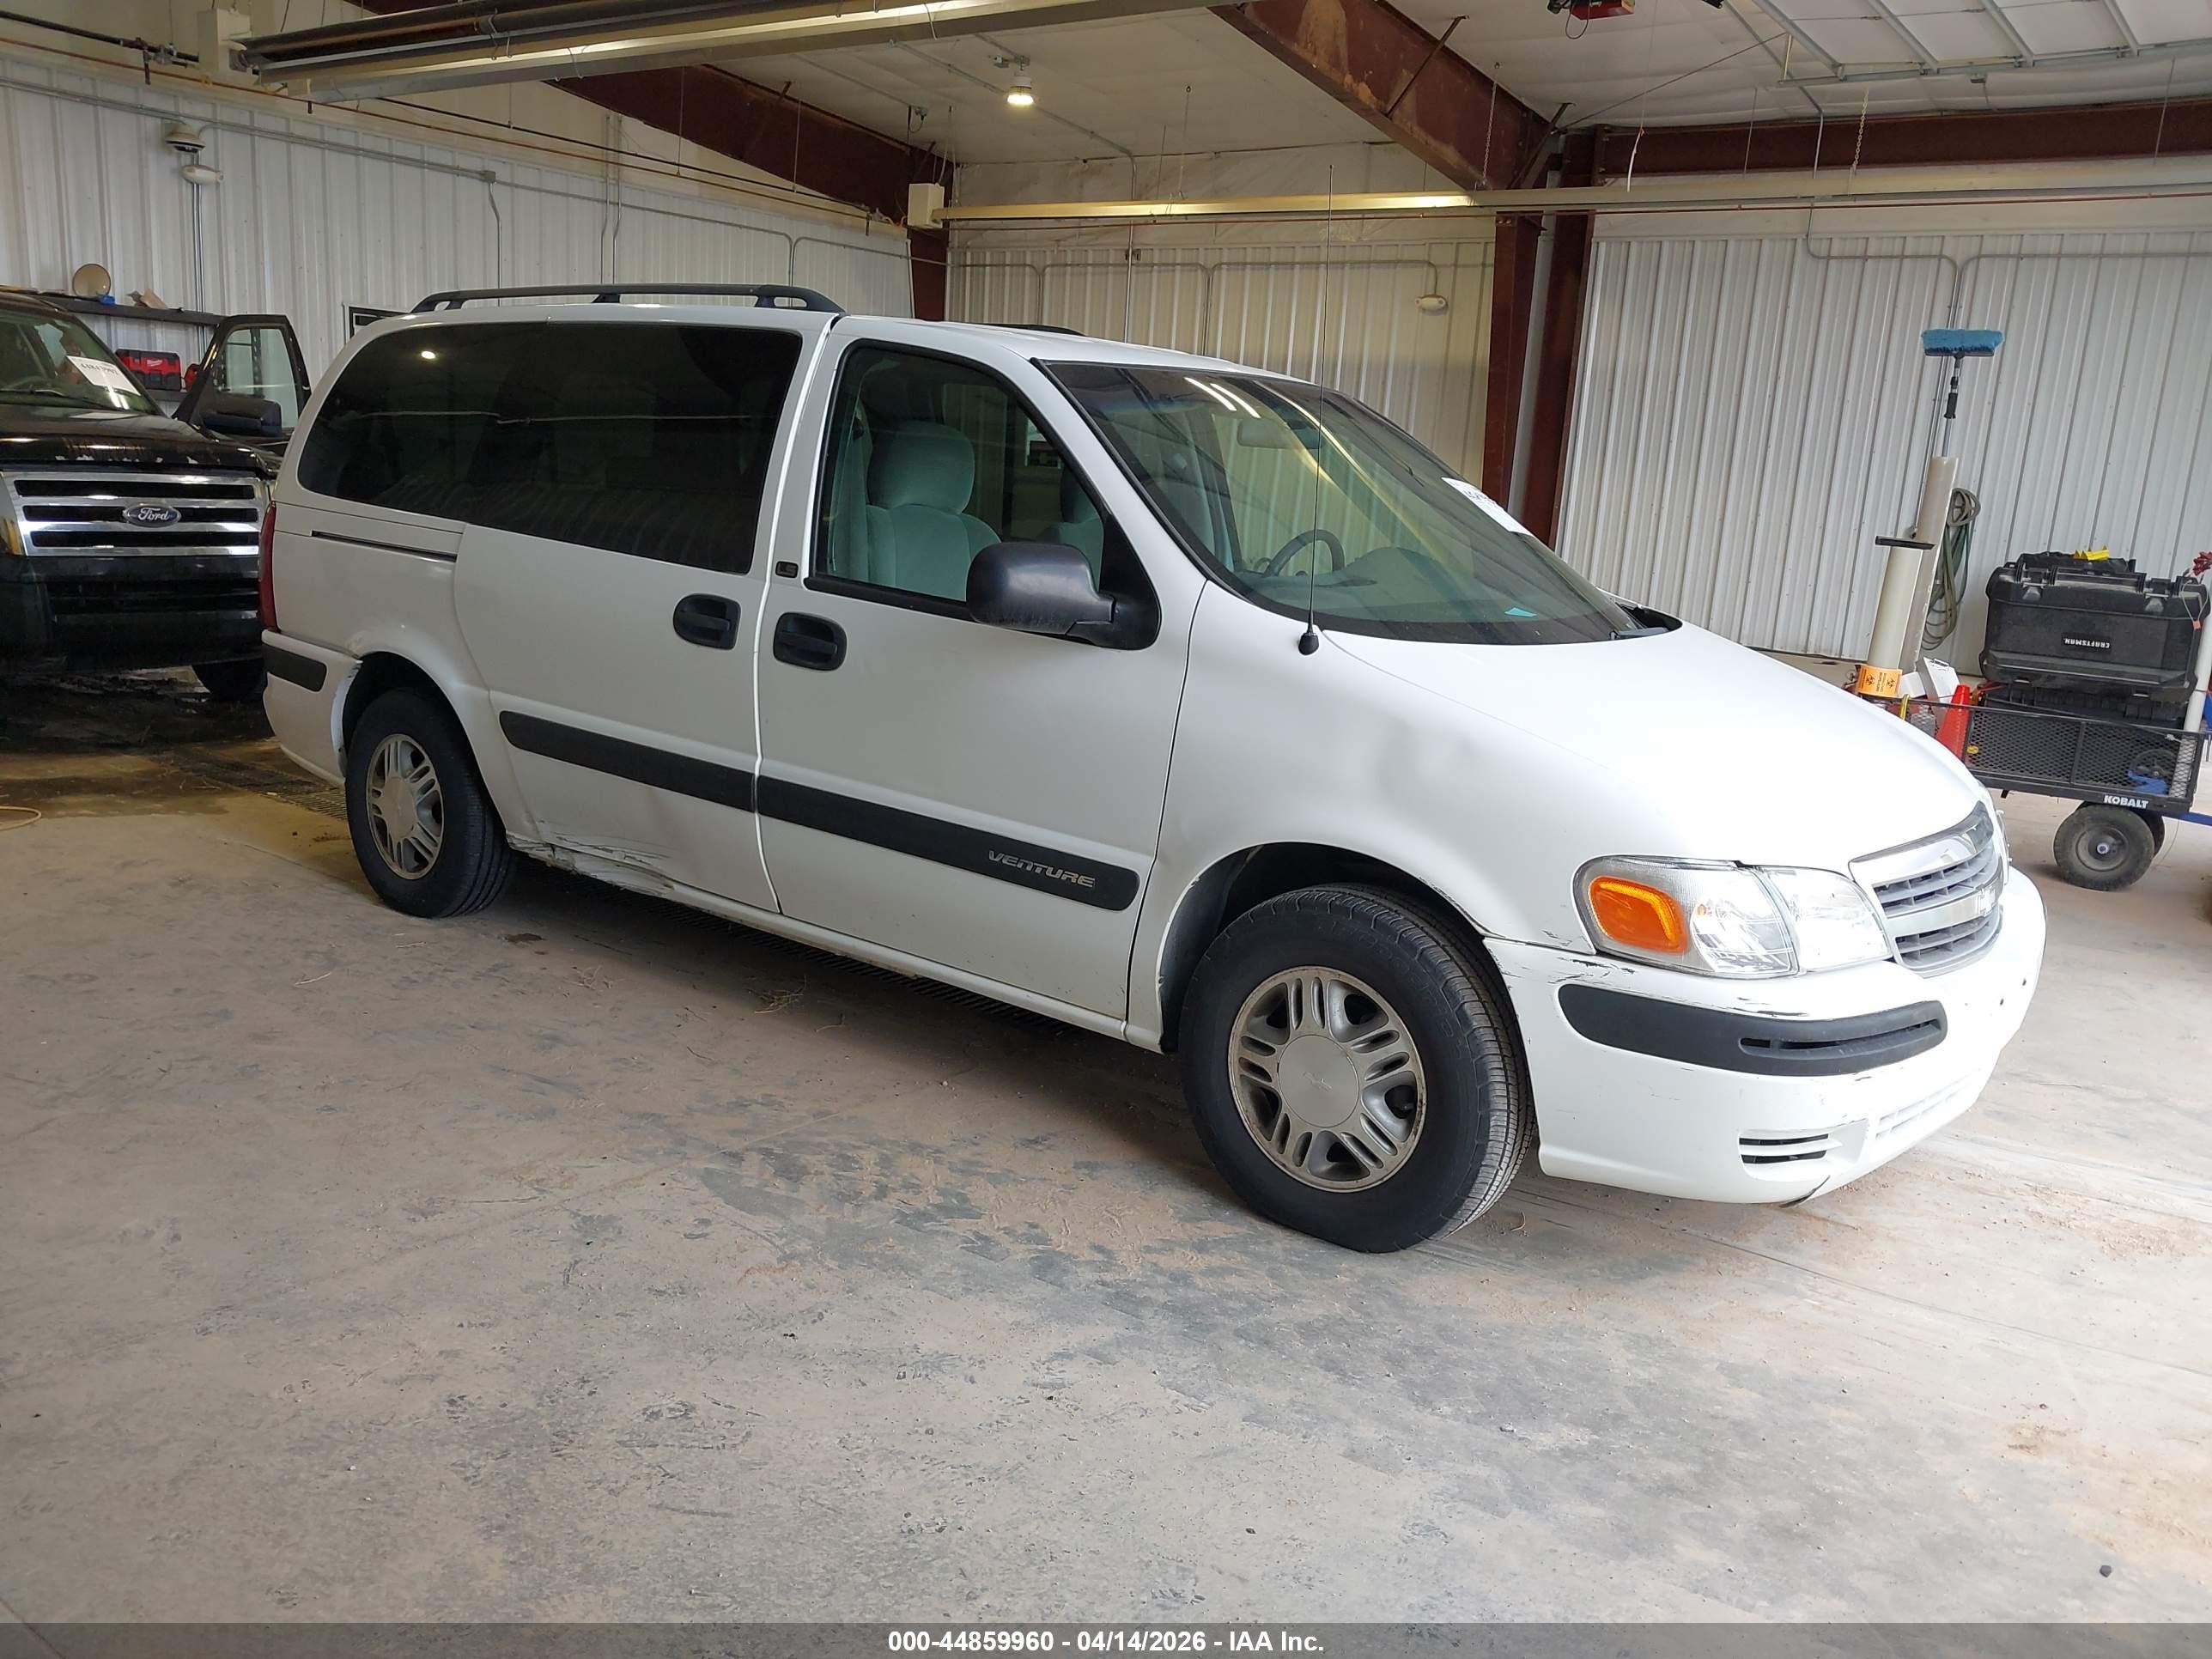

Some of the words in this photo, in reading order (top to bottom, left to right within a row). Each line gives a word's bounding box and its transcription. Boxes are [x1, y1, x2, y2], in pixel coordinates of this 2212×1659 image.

[138, 507, 169, 520] Ford
[2104, 795, 2148, 809] KOBALT
[988, 850, 1096, 888] VENTURE
